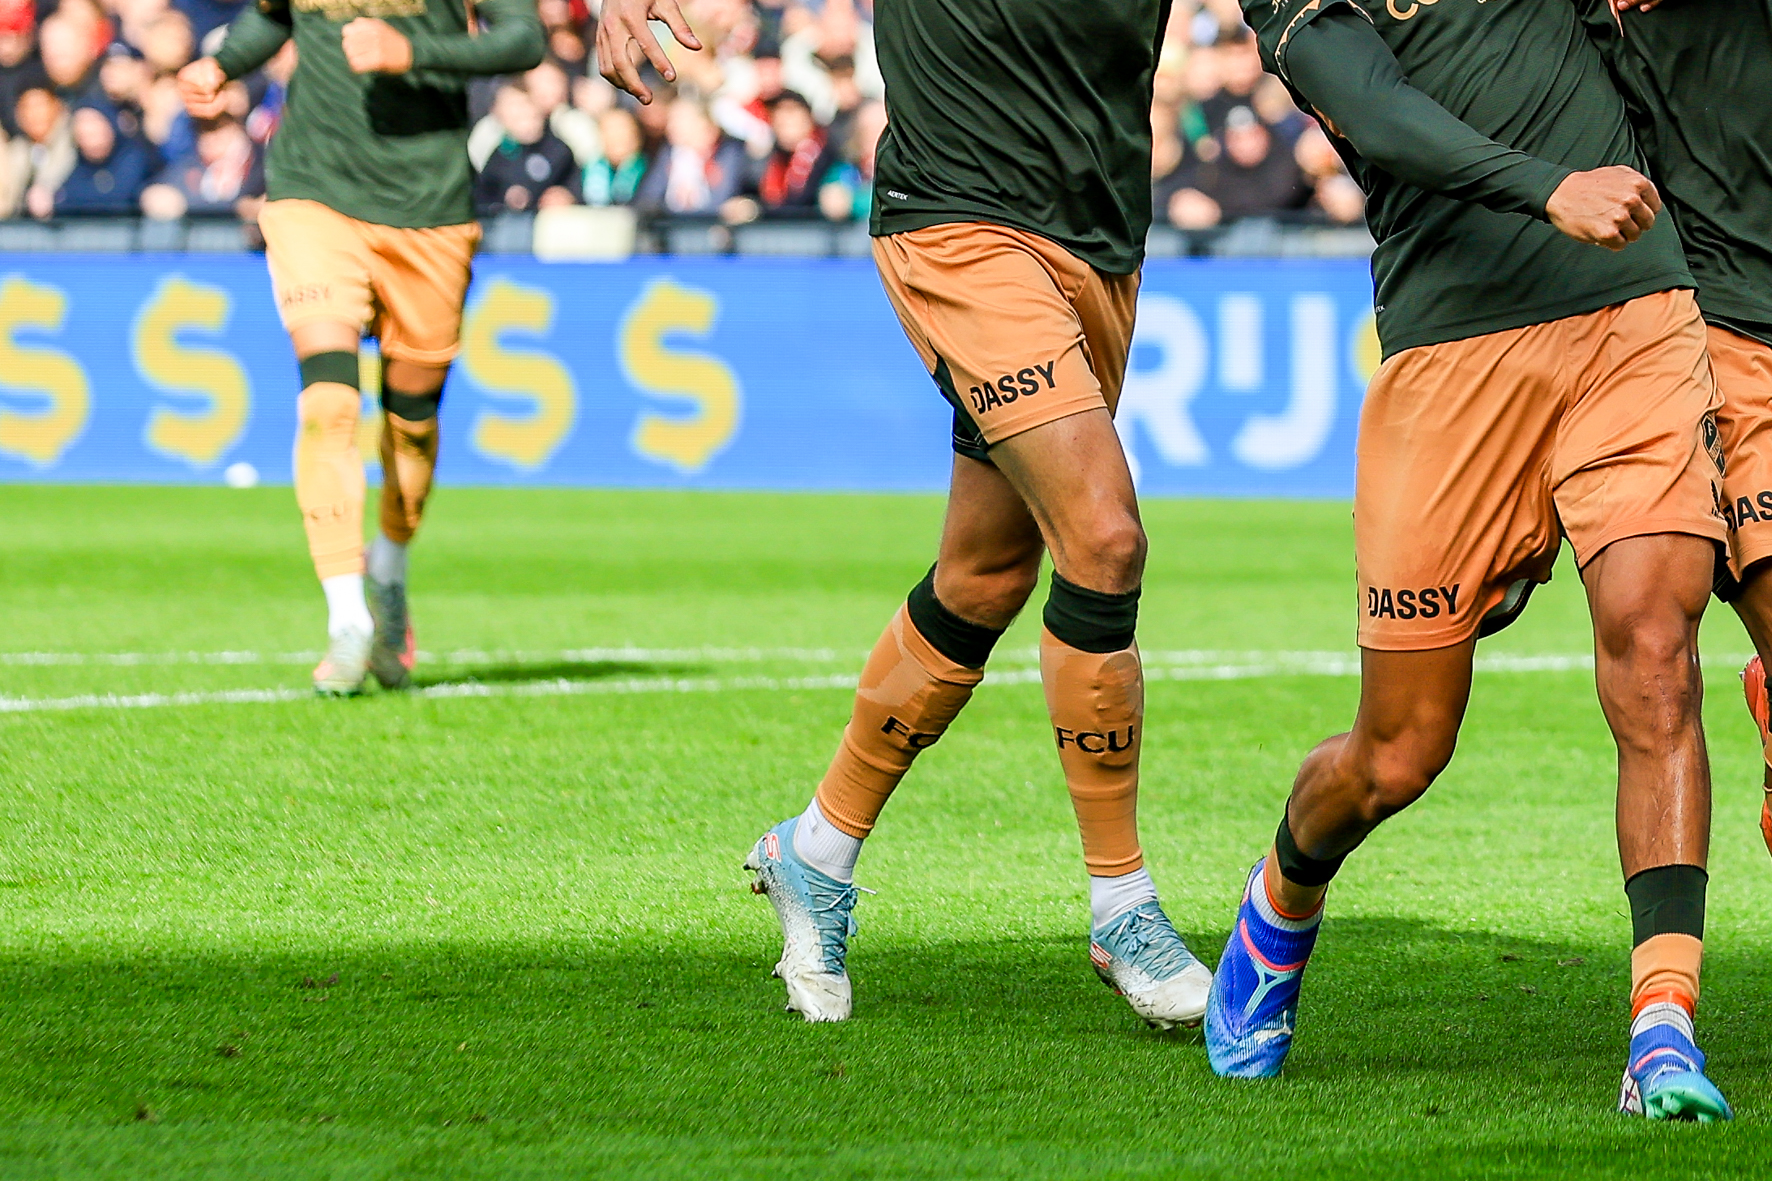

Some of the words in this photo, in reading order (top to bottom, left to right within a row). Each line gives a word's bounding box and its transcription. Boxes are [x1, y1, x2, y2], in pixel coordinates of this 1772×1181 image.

[969, 360, 1056, 415] DASSY
[1120, 293, 1338, 470] RIJ
[1367, 582, 1461, 620] DASSY
[880, 715, 942, 749] FC
[1055, 724, 1135, 754] FCU
